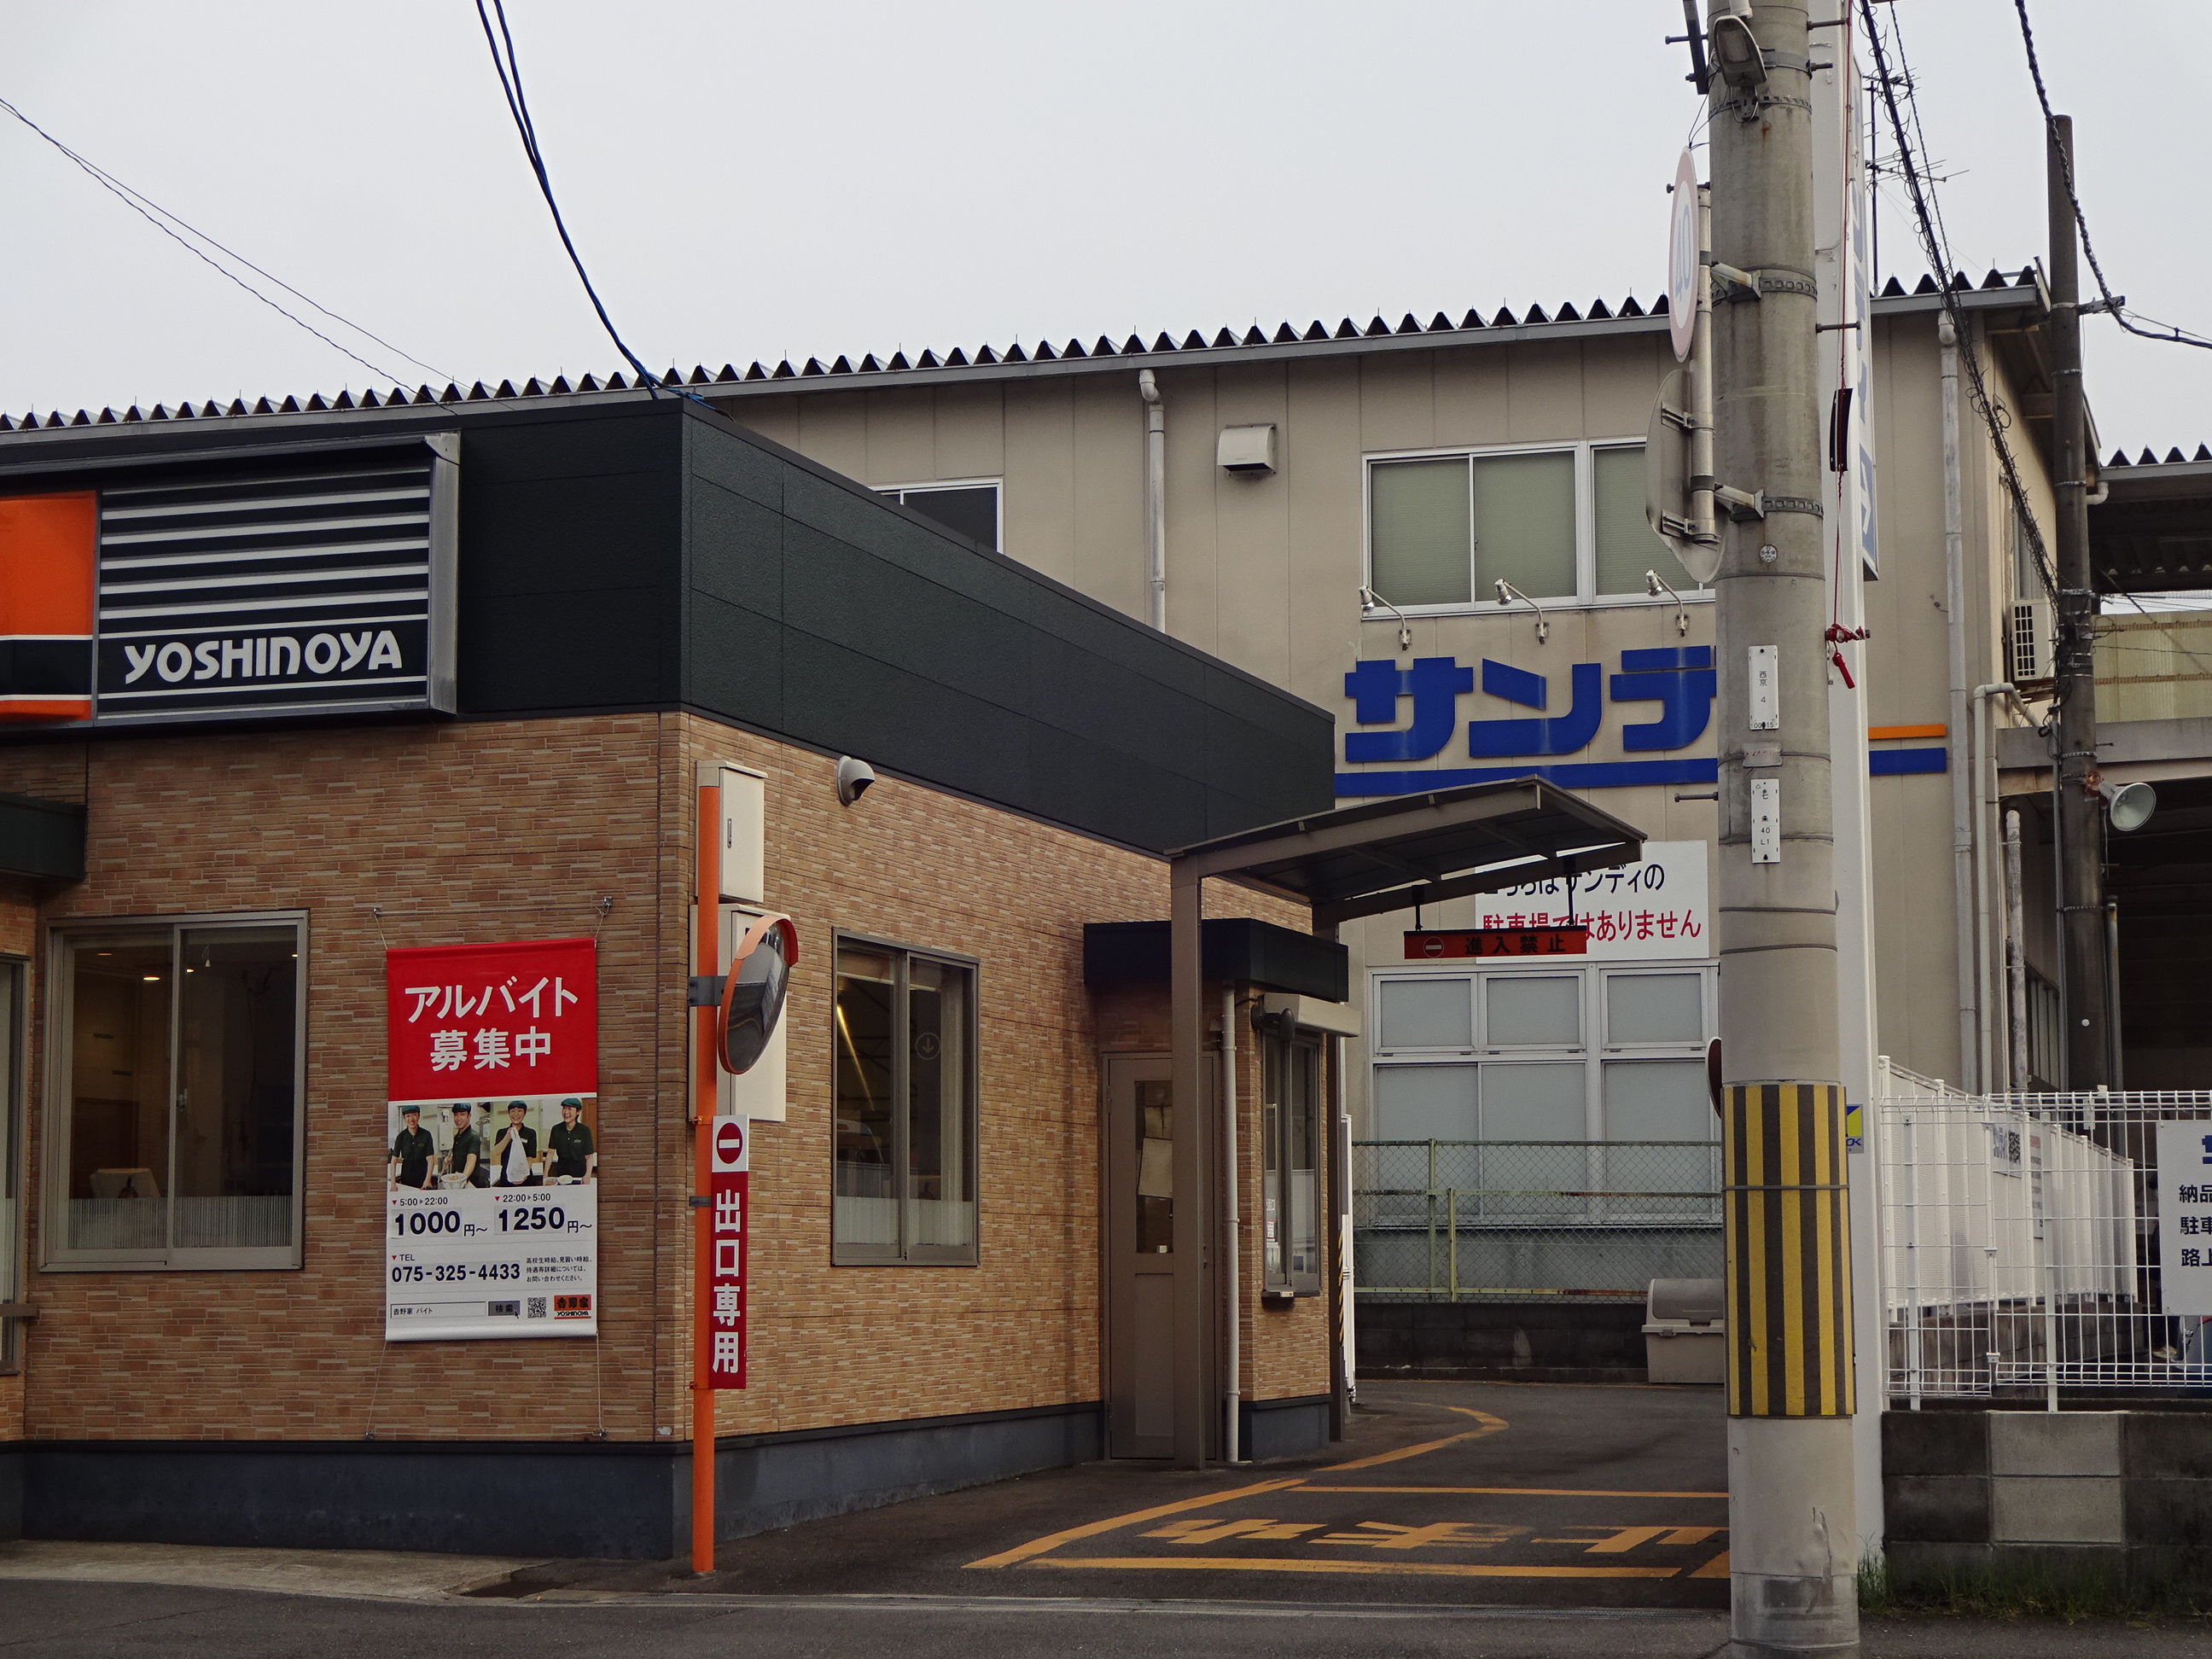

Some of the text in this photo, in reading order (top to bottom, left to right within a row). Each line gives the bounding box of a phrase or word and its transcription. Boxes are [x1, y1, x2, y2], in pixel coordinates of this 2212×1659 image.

[1675, 204, 1691, 300] 40
[125, 630, 402, 685] YOSHINOYA
[1759, 671, 1767, 687] 西京
[1465, 934, 1566, 955] 進入禁止
[405, 975, 579, 1023] アルバイト
[430, 1026, 551, 1072] 募集中
[392, 1263, 521, 1283] 075-325-4433
[712, 1190, 741, 1374] 出口専用
[496, 1304, 514, 1313] 検索
